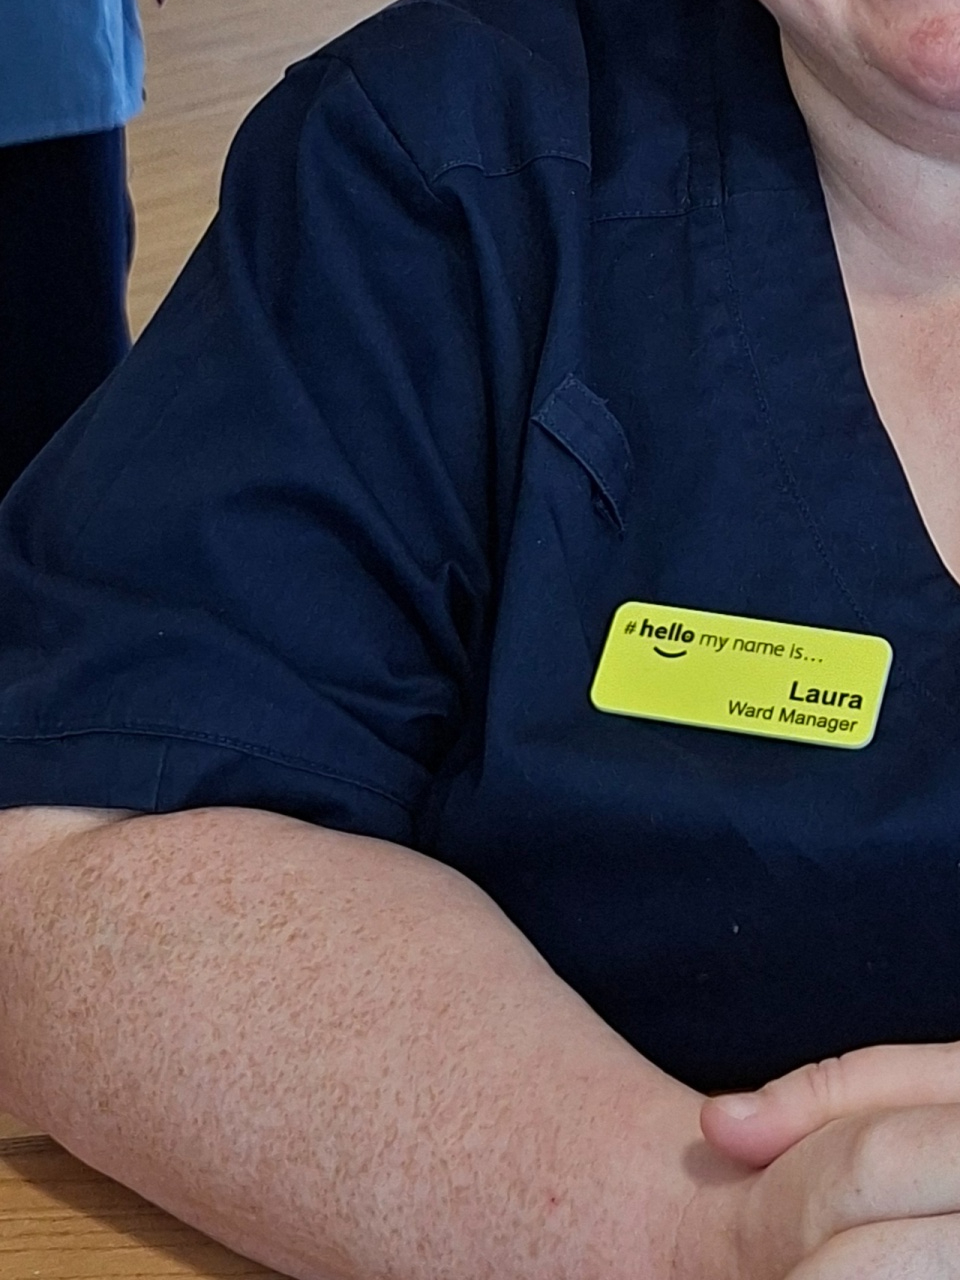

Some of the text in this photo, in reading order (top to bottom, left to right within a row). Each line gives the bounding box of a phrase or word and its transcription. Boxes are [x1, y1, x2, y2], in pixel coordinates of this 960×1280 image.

[699, 634, 730, 653] my
[732, 638, 786, 657] name
[789, 680, 863, 710] Laura
[728, 700, 859, 733] Ward Manager
